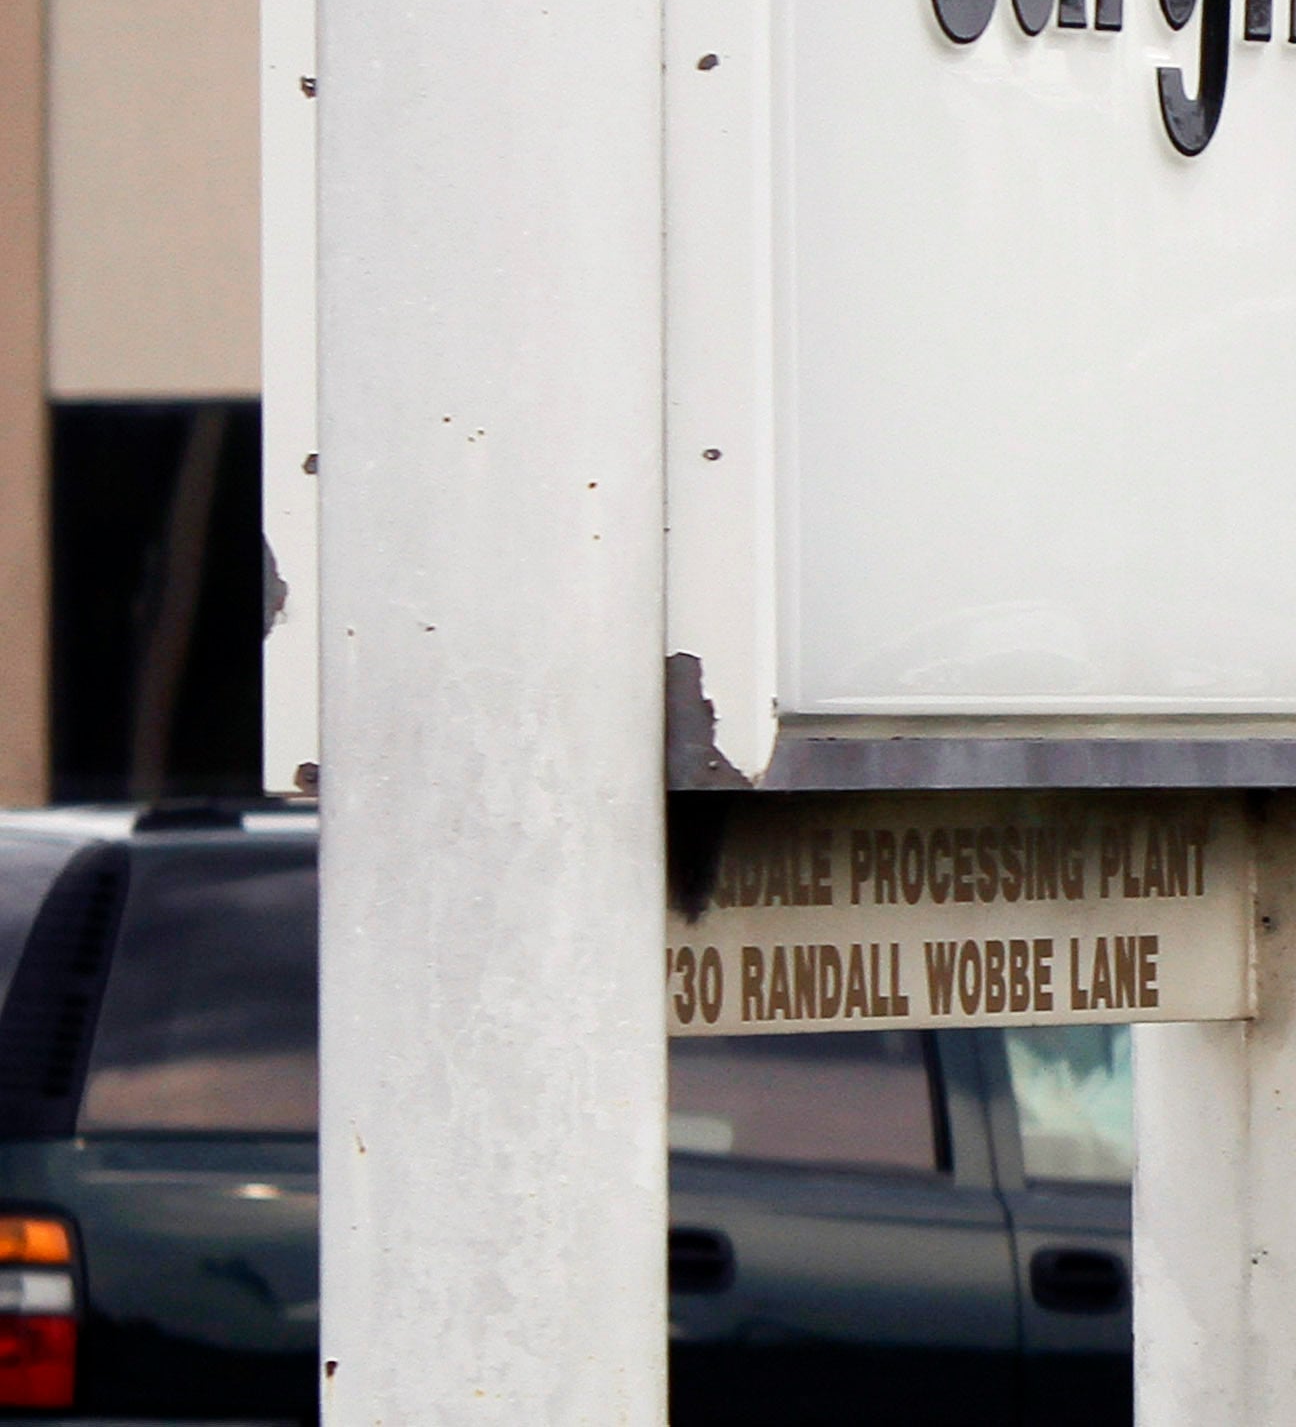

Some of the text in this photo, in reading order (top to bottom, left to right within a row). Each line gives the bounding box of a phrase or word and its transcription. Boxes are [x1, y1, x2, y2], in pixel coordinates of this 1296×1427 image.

[850, 827, 1084, 905] PROCESSING
[1102, 823, 1206, 899] PLANT
[666, 934, 1159, 1024] 30 RANDALL WOBBE LANE
